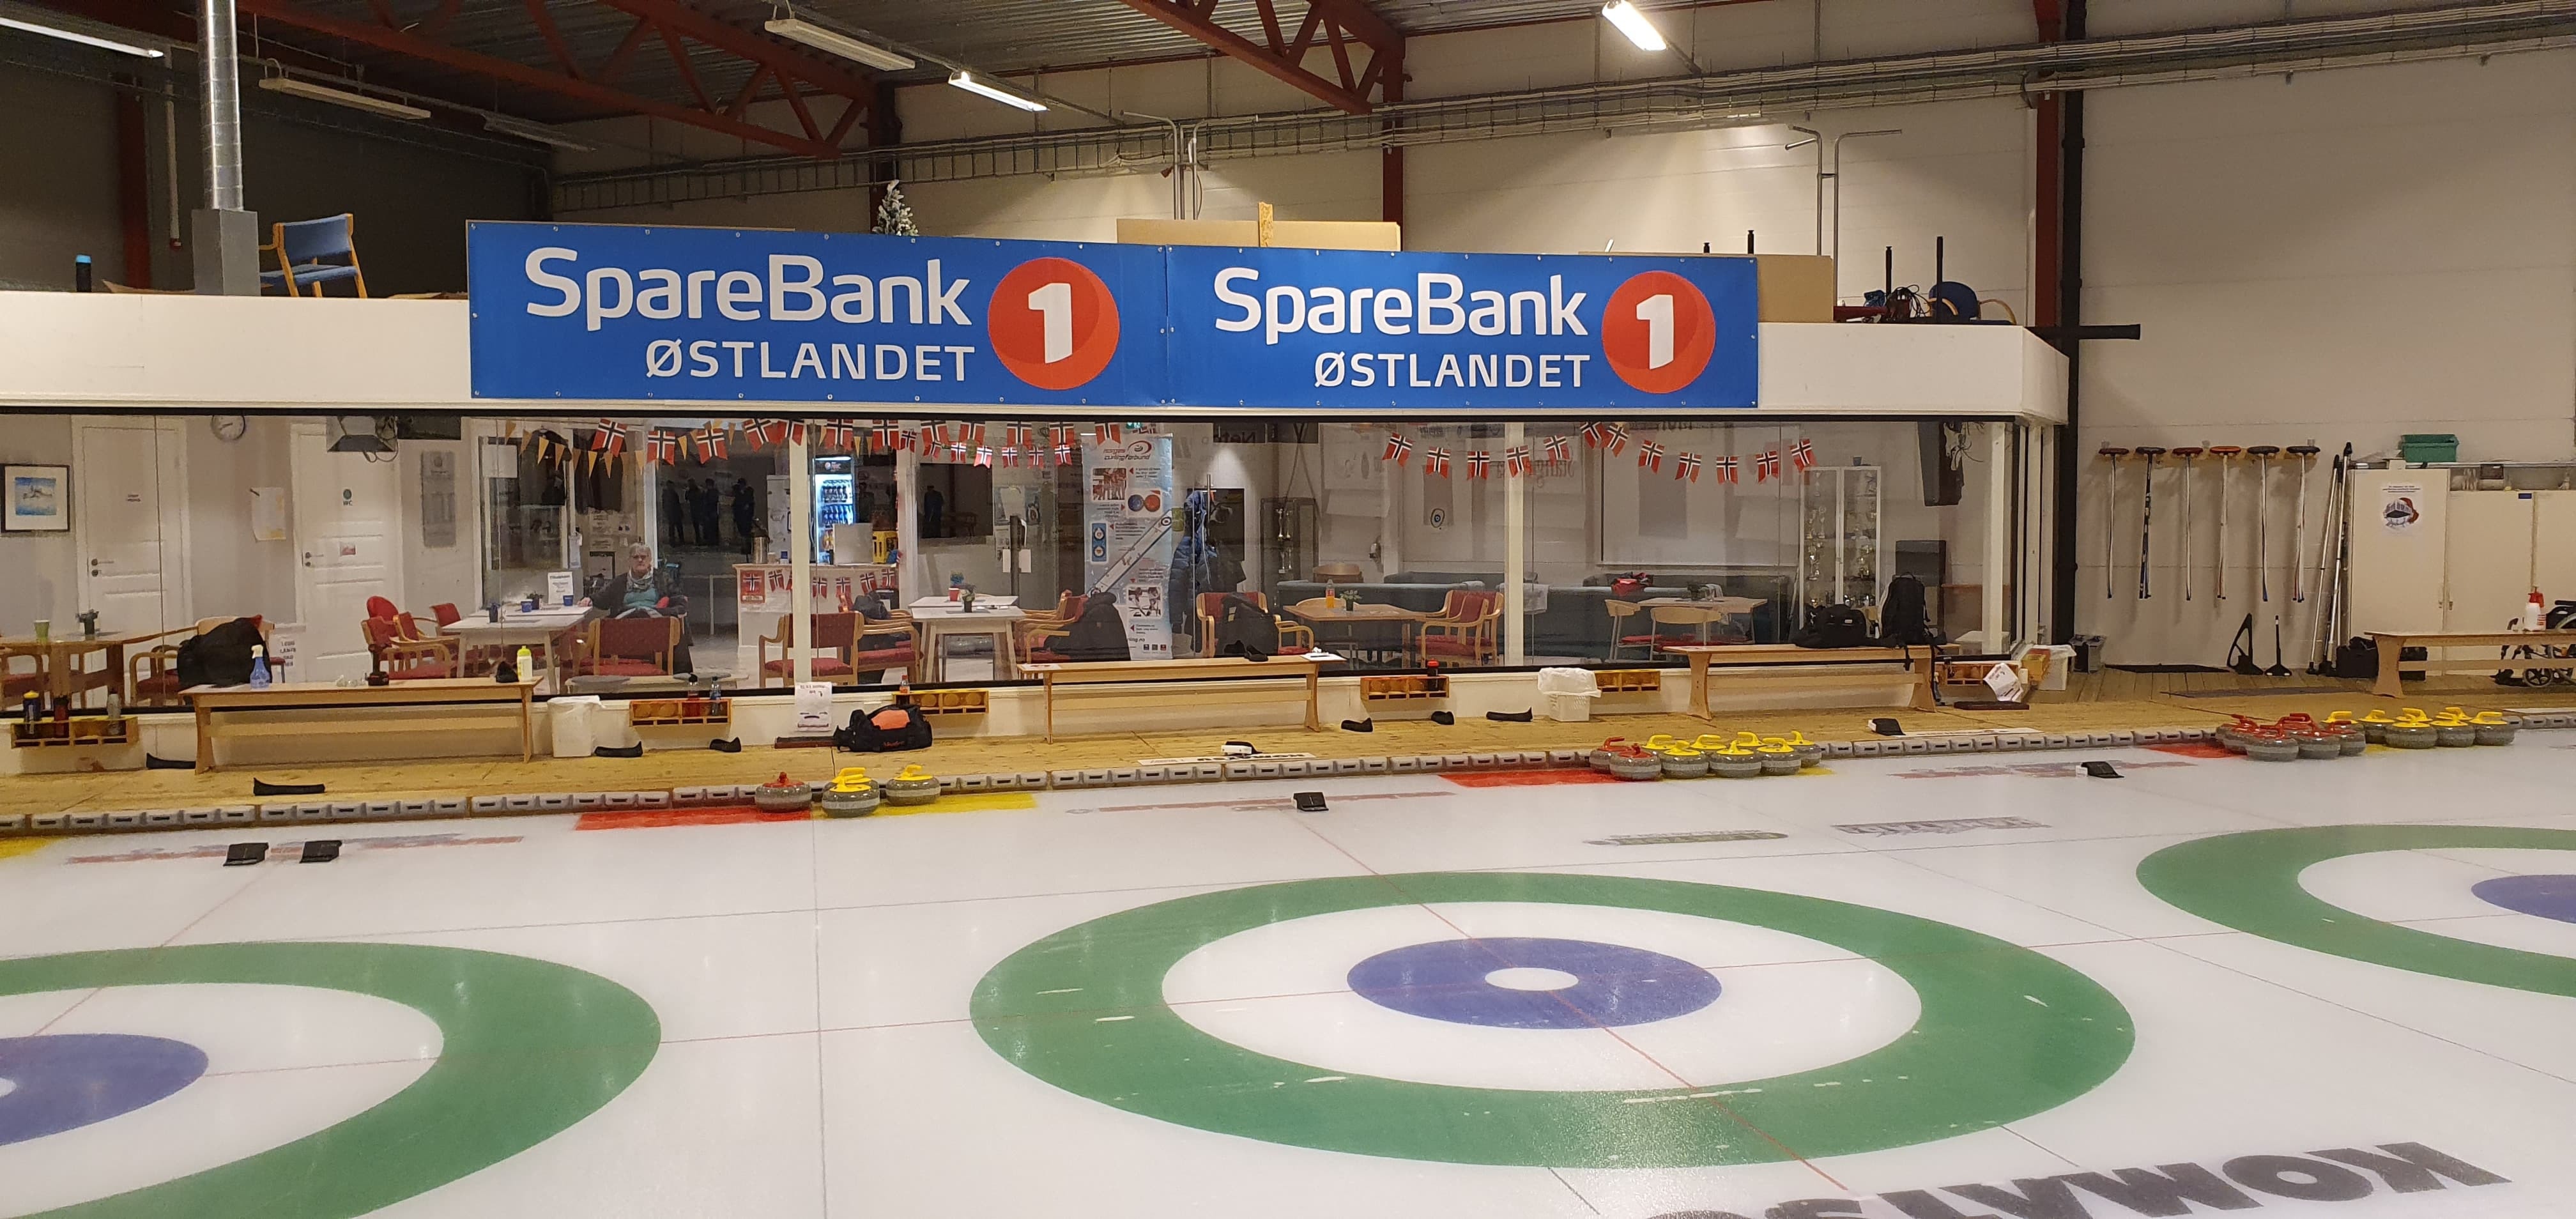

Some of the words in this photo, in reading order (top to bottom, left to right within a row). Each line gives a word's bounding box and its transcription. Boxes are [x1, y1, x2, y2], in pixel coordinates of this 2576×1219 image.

[525, 247, 972, 332] SpareBank
[1026, 282, 1073, 363] 1
[1214, 267, 1588, 345] SpareBank
[1636, 294, 1675, 370] 1
[646, 338, 975, 381] ØSTLANDET
[1314, 351, 1590, 388] ØSTLANDET
[1646, 1142, 2511, 1219] KOMAT
